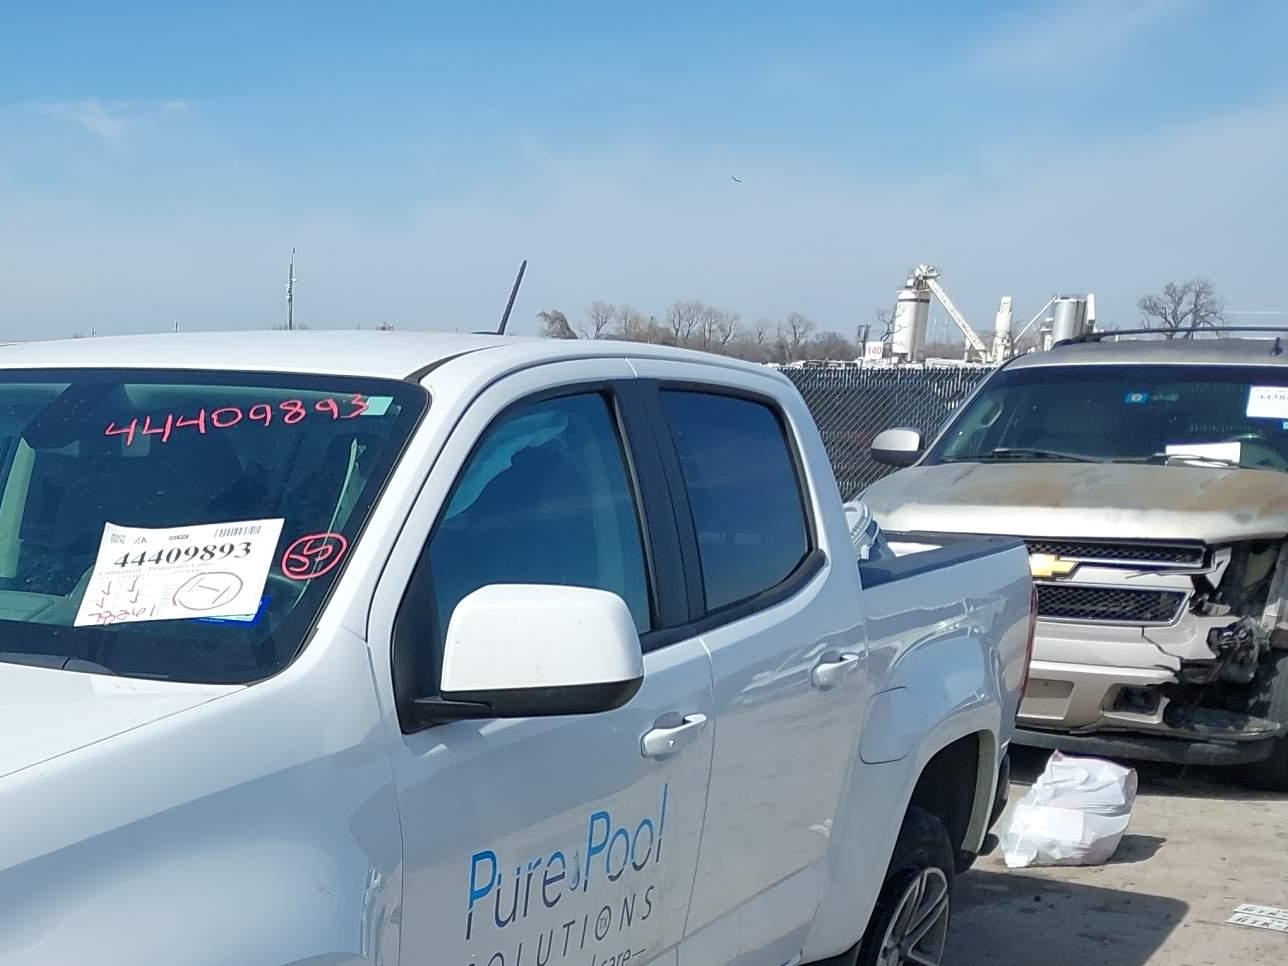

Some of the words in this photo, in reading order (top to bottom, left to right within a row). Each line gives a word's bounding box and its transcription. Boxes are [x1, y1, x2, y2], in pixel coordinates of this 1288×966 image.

[105, 394, 369, 446] 44409893
[113, 541, 253, 568] 44409893
[465, 850, 566, 941] Pure
[583, 783, 668, 893] Pool
